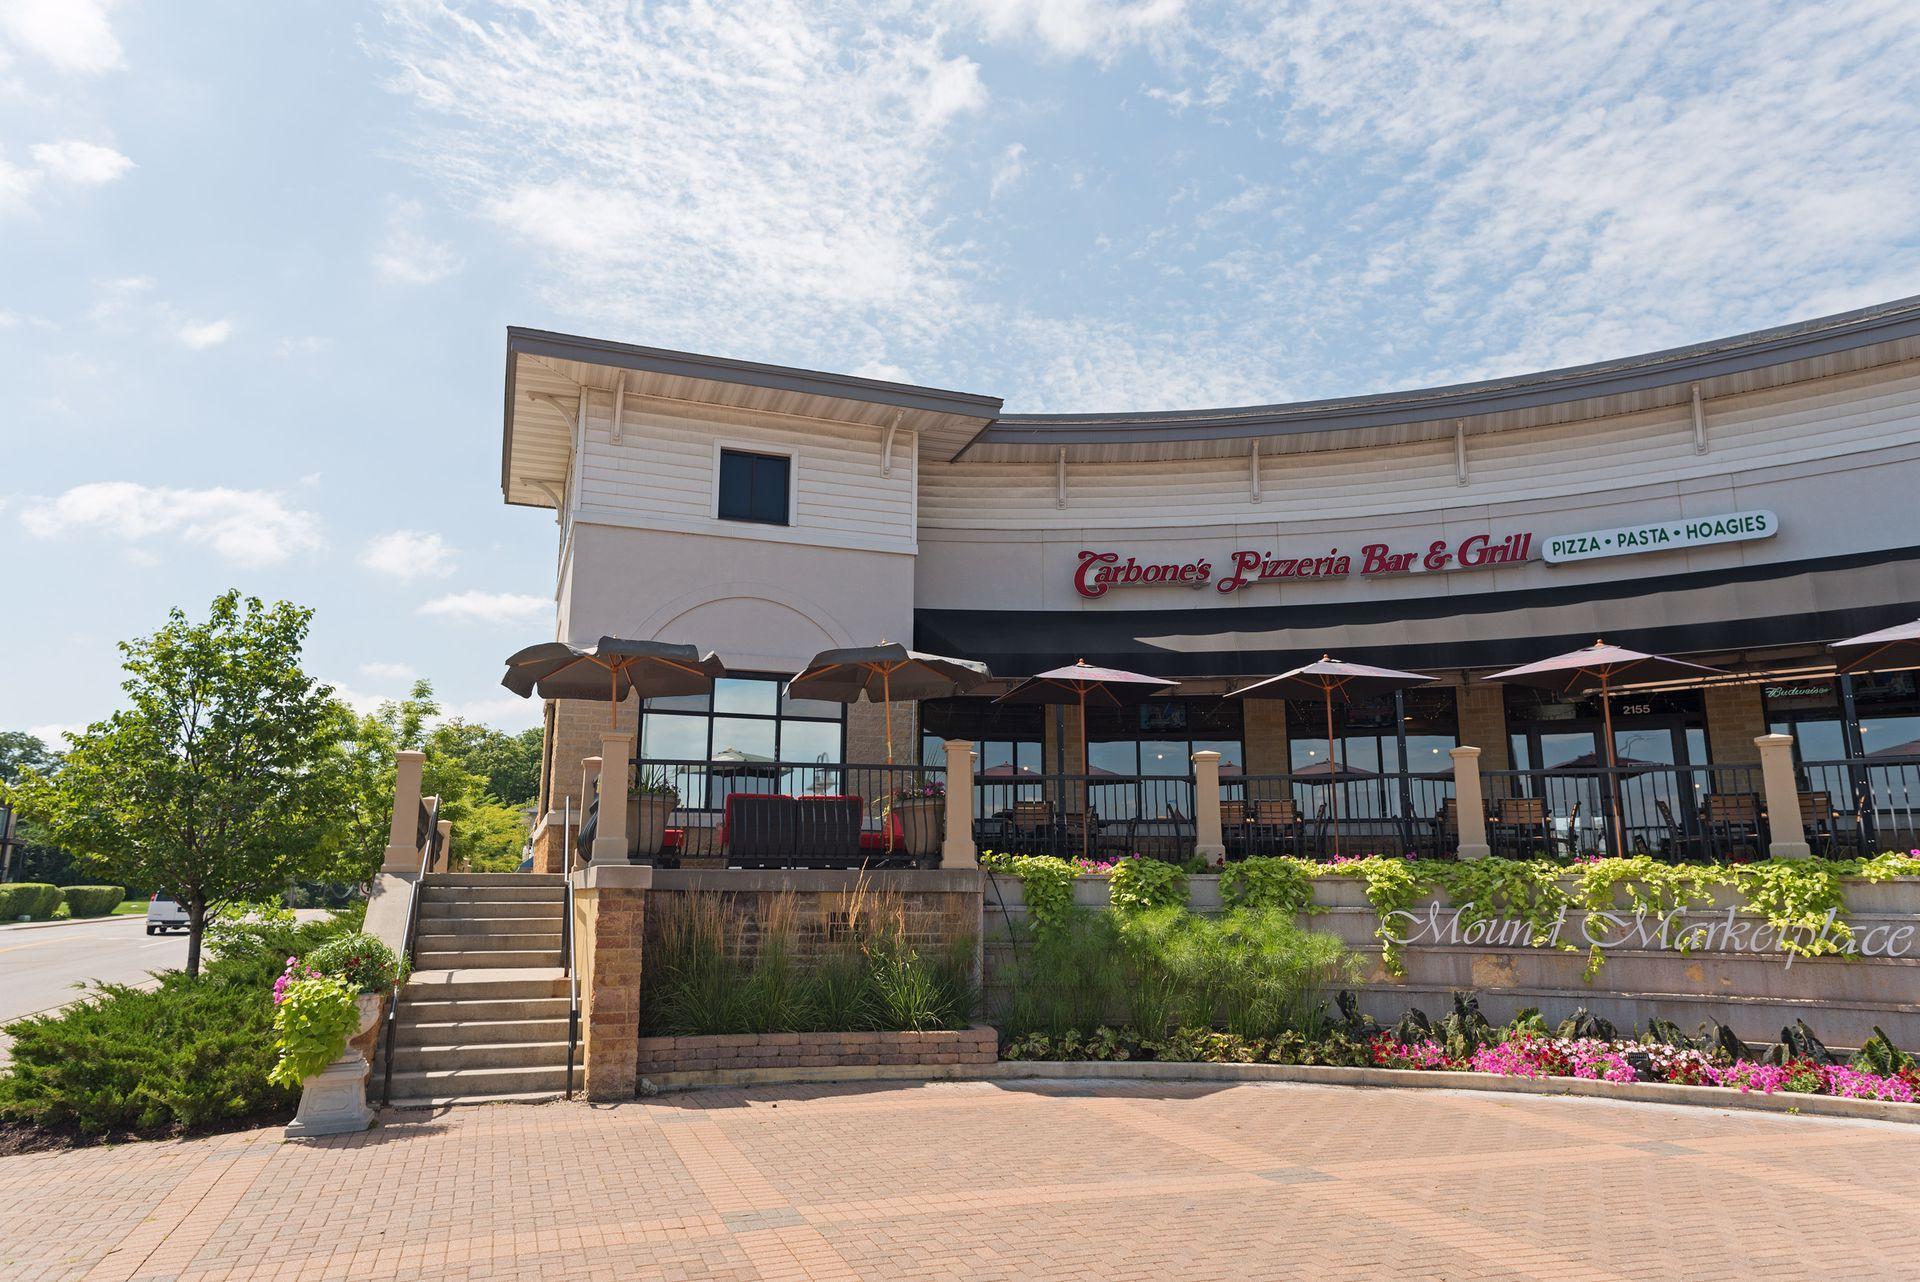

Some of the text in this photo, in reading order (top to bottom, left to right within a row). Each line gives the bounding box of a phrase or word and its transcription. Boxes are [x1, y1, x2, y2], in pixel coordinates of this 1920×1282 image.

[1552, 515, 1766, 556] PIZZA PASTA HOAGIES
[1073, 532, 1532, 598] Carbone's Pizzeria Bar & Grill
[1765, 686, 1832, 698] Budweiser
[1622, 704, 1651, 715] 2155
